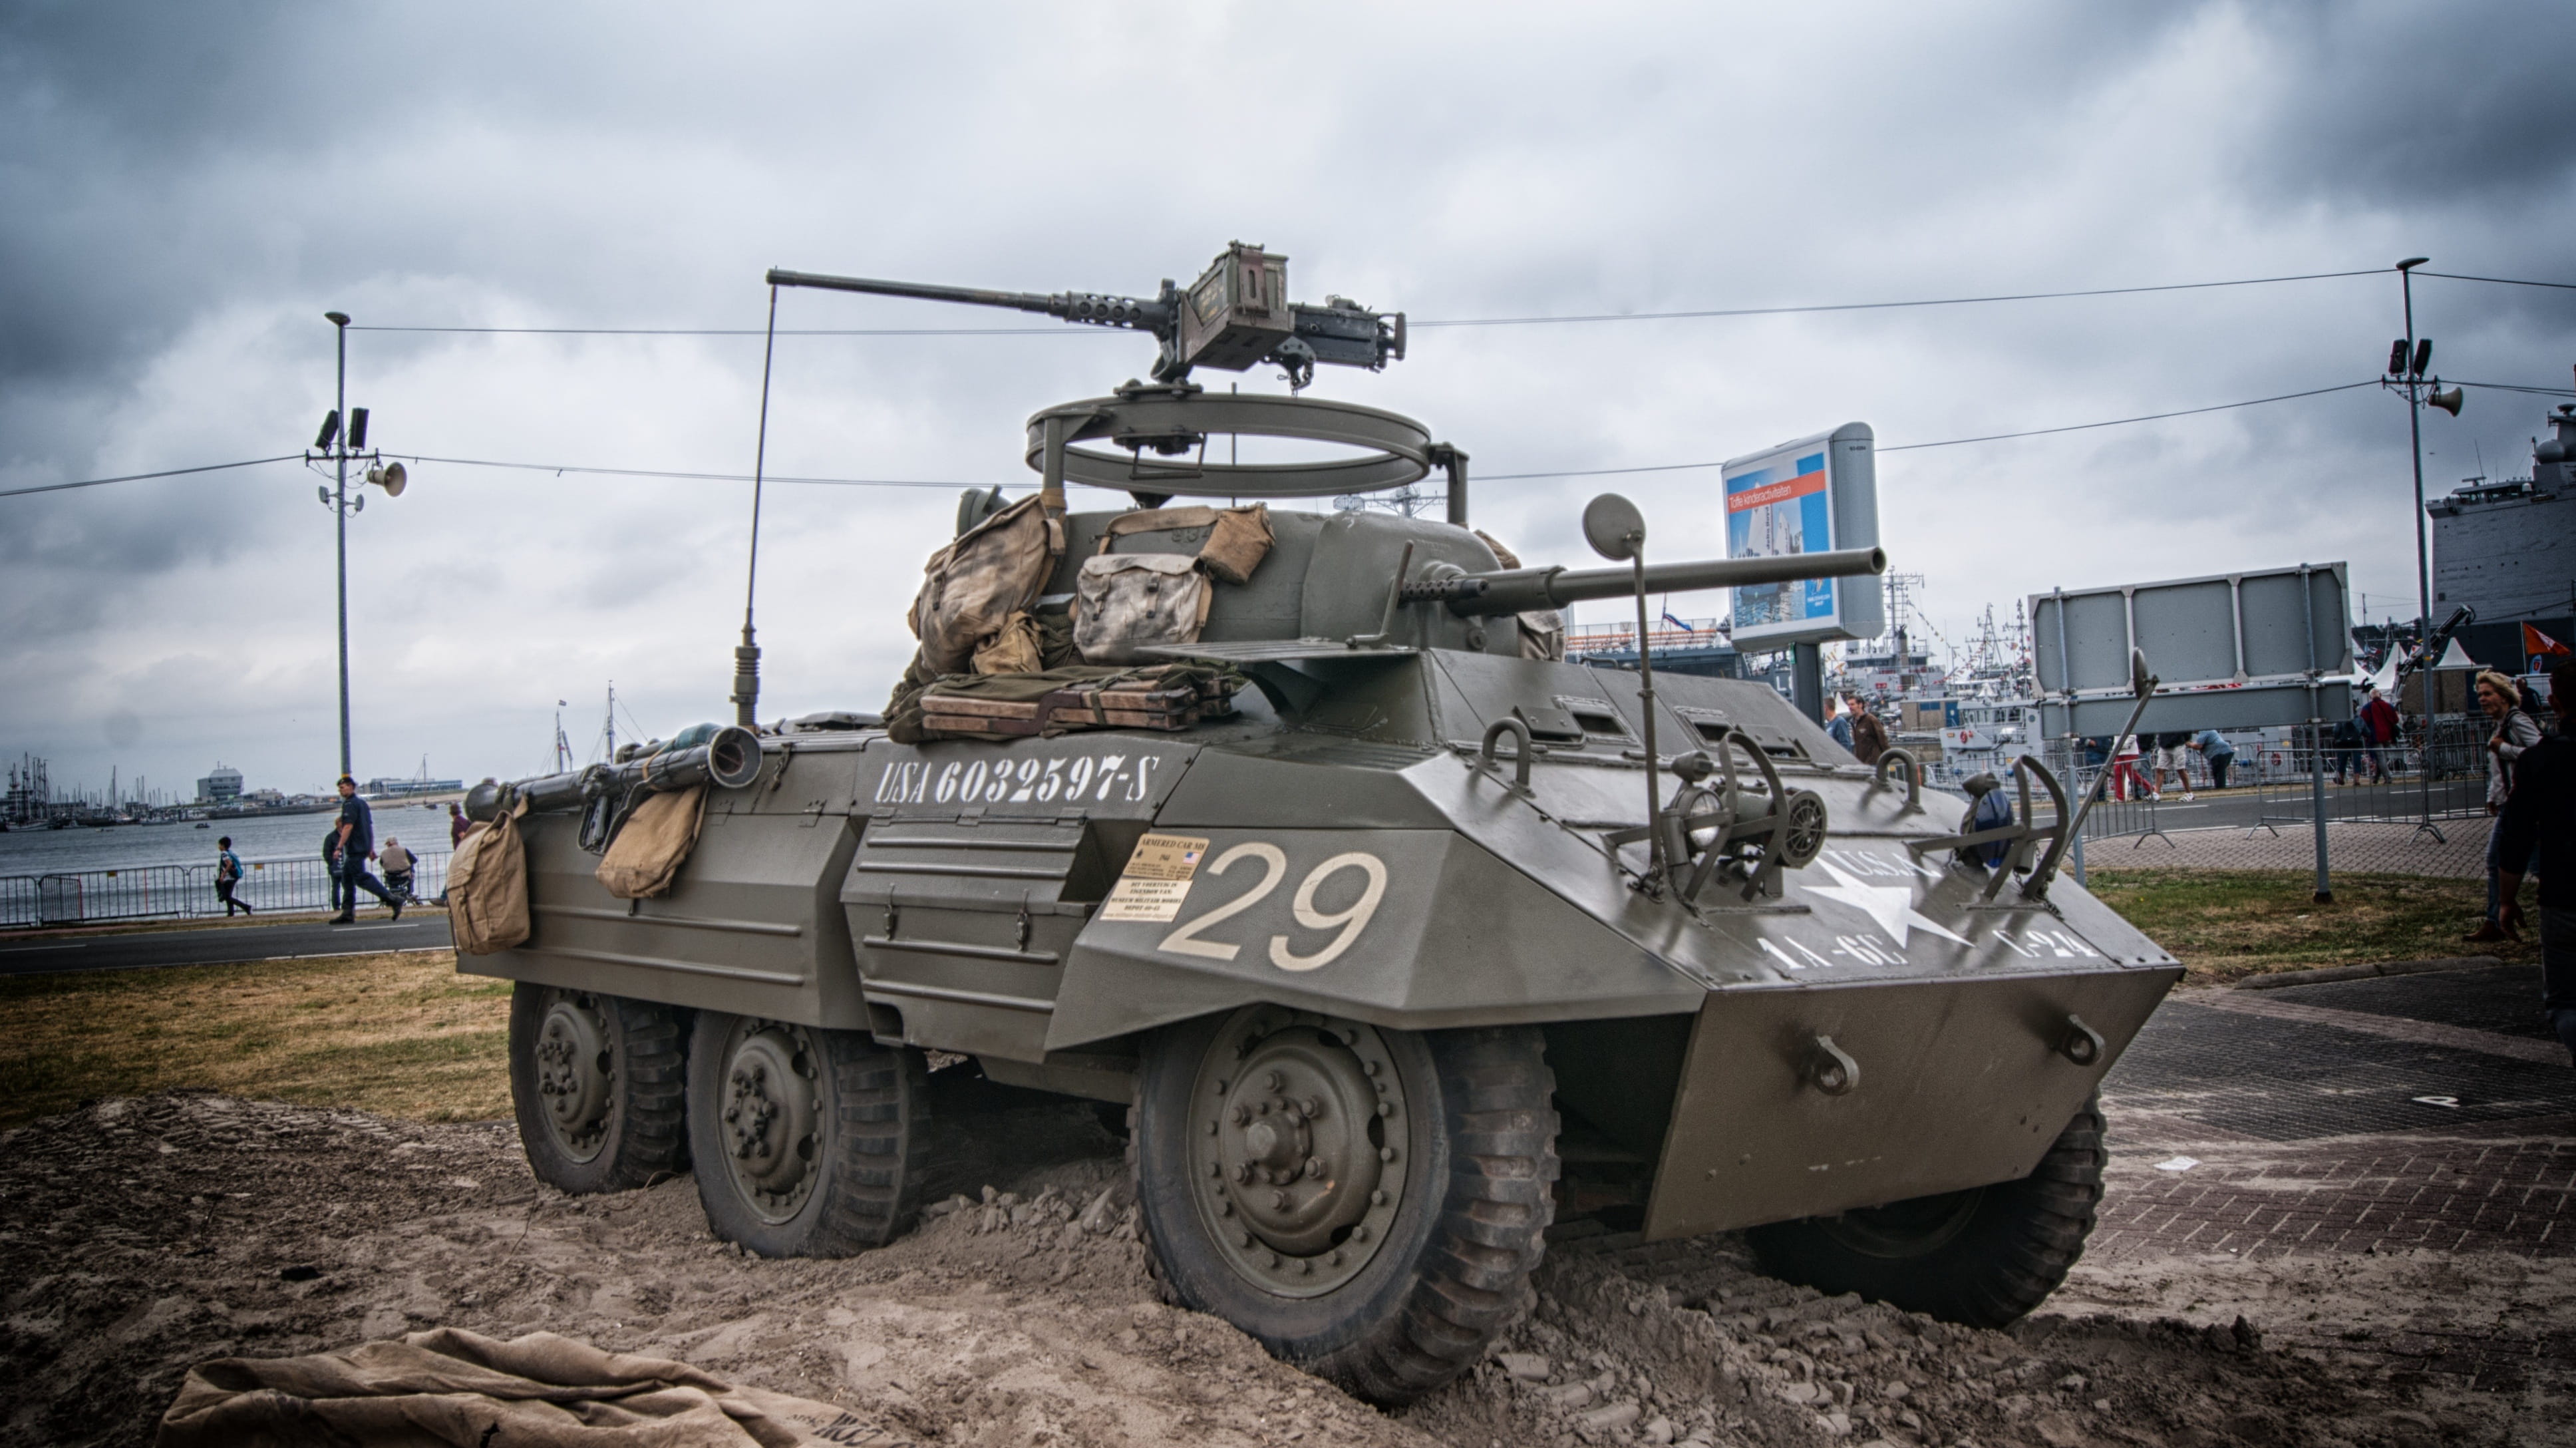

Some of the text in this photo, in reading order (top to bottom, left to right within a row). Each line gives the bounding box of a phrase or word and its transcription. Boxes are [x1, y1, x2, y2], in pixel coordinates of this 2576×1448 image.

[1729, 485, 1792, 508] Toffe kinderactiviteiten
[874, 755, 1160, 804] USA 6032597-S
[1177, 840, 1193, 850] CAR
[1157, 842, 1387, 972] 29
